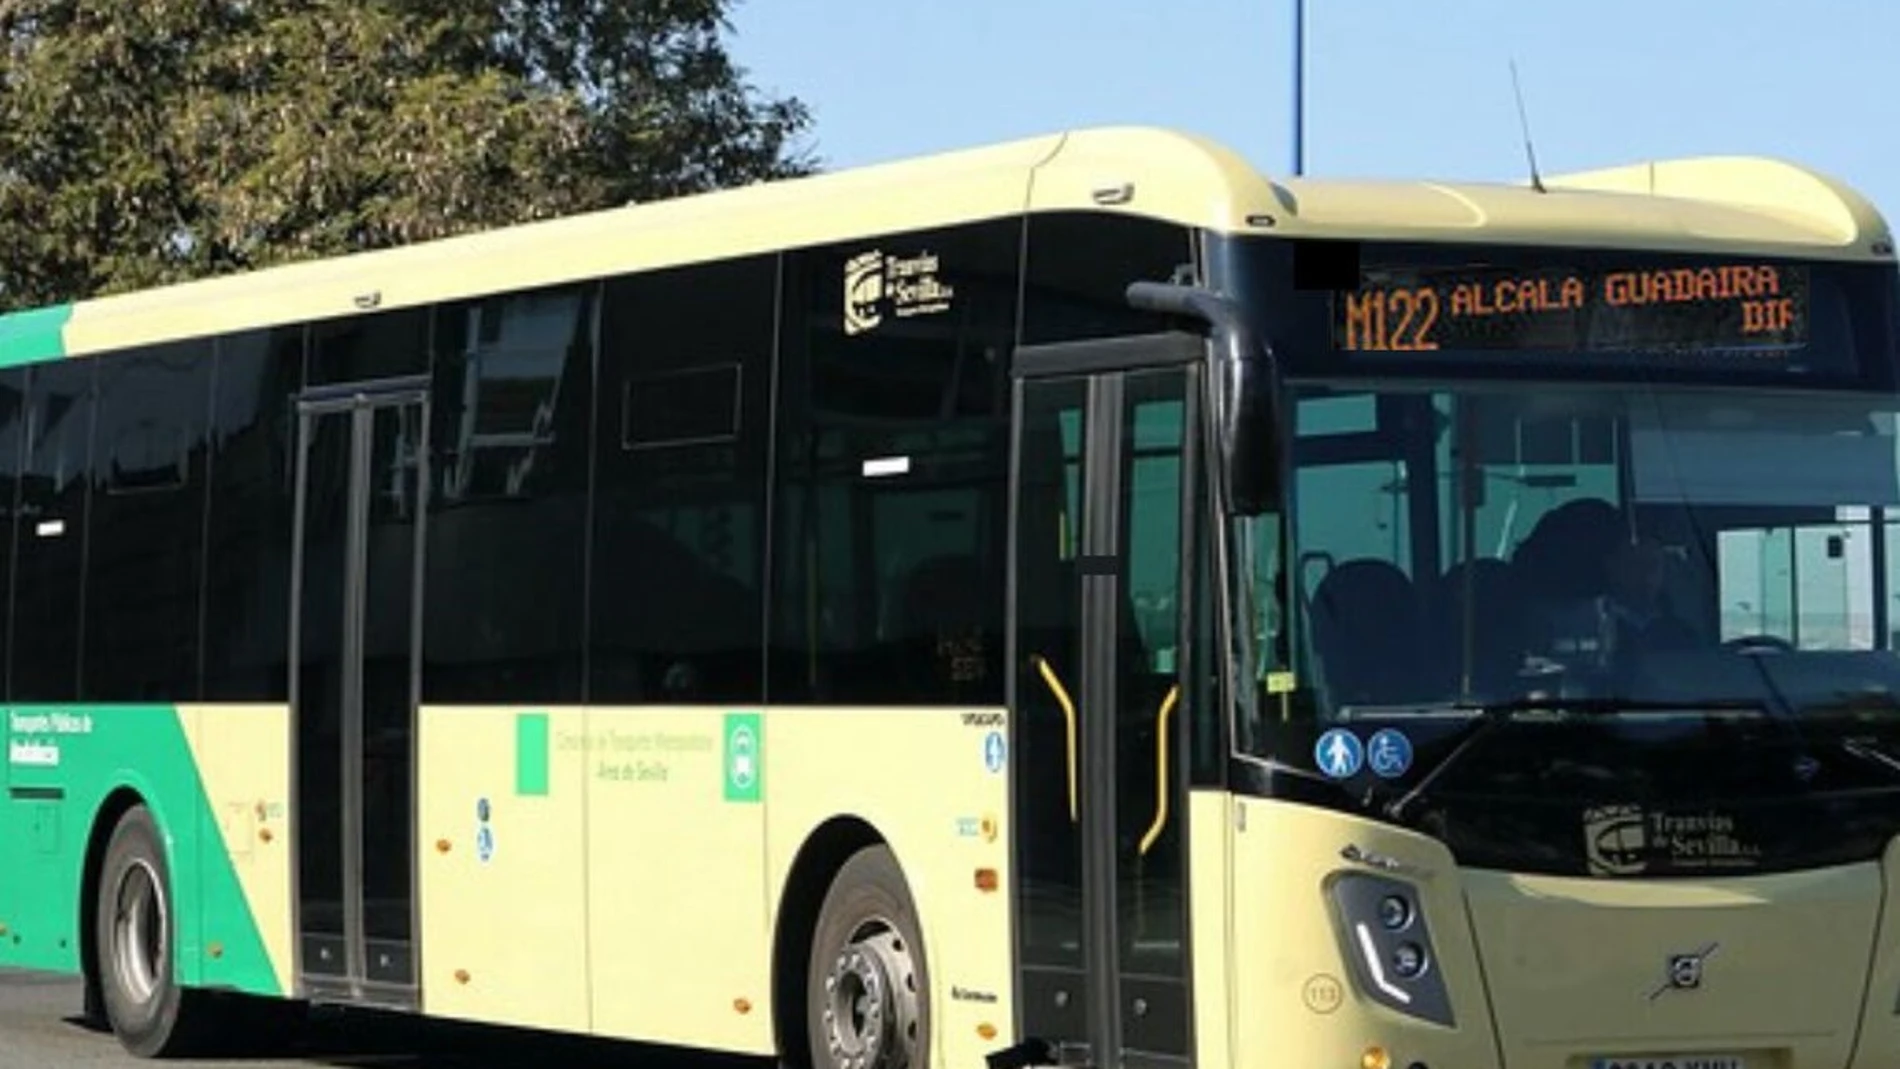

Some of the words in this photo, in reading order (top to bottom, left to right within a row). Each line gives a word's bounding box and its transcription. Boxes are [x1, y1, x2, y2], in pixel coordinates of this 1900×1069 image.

[1346, 286, 1440, 351] M122
[1452, 277, 1584, 317] ALCALA
[1604, 265, 1780, 306] GUADAIRA
